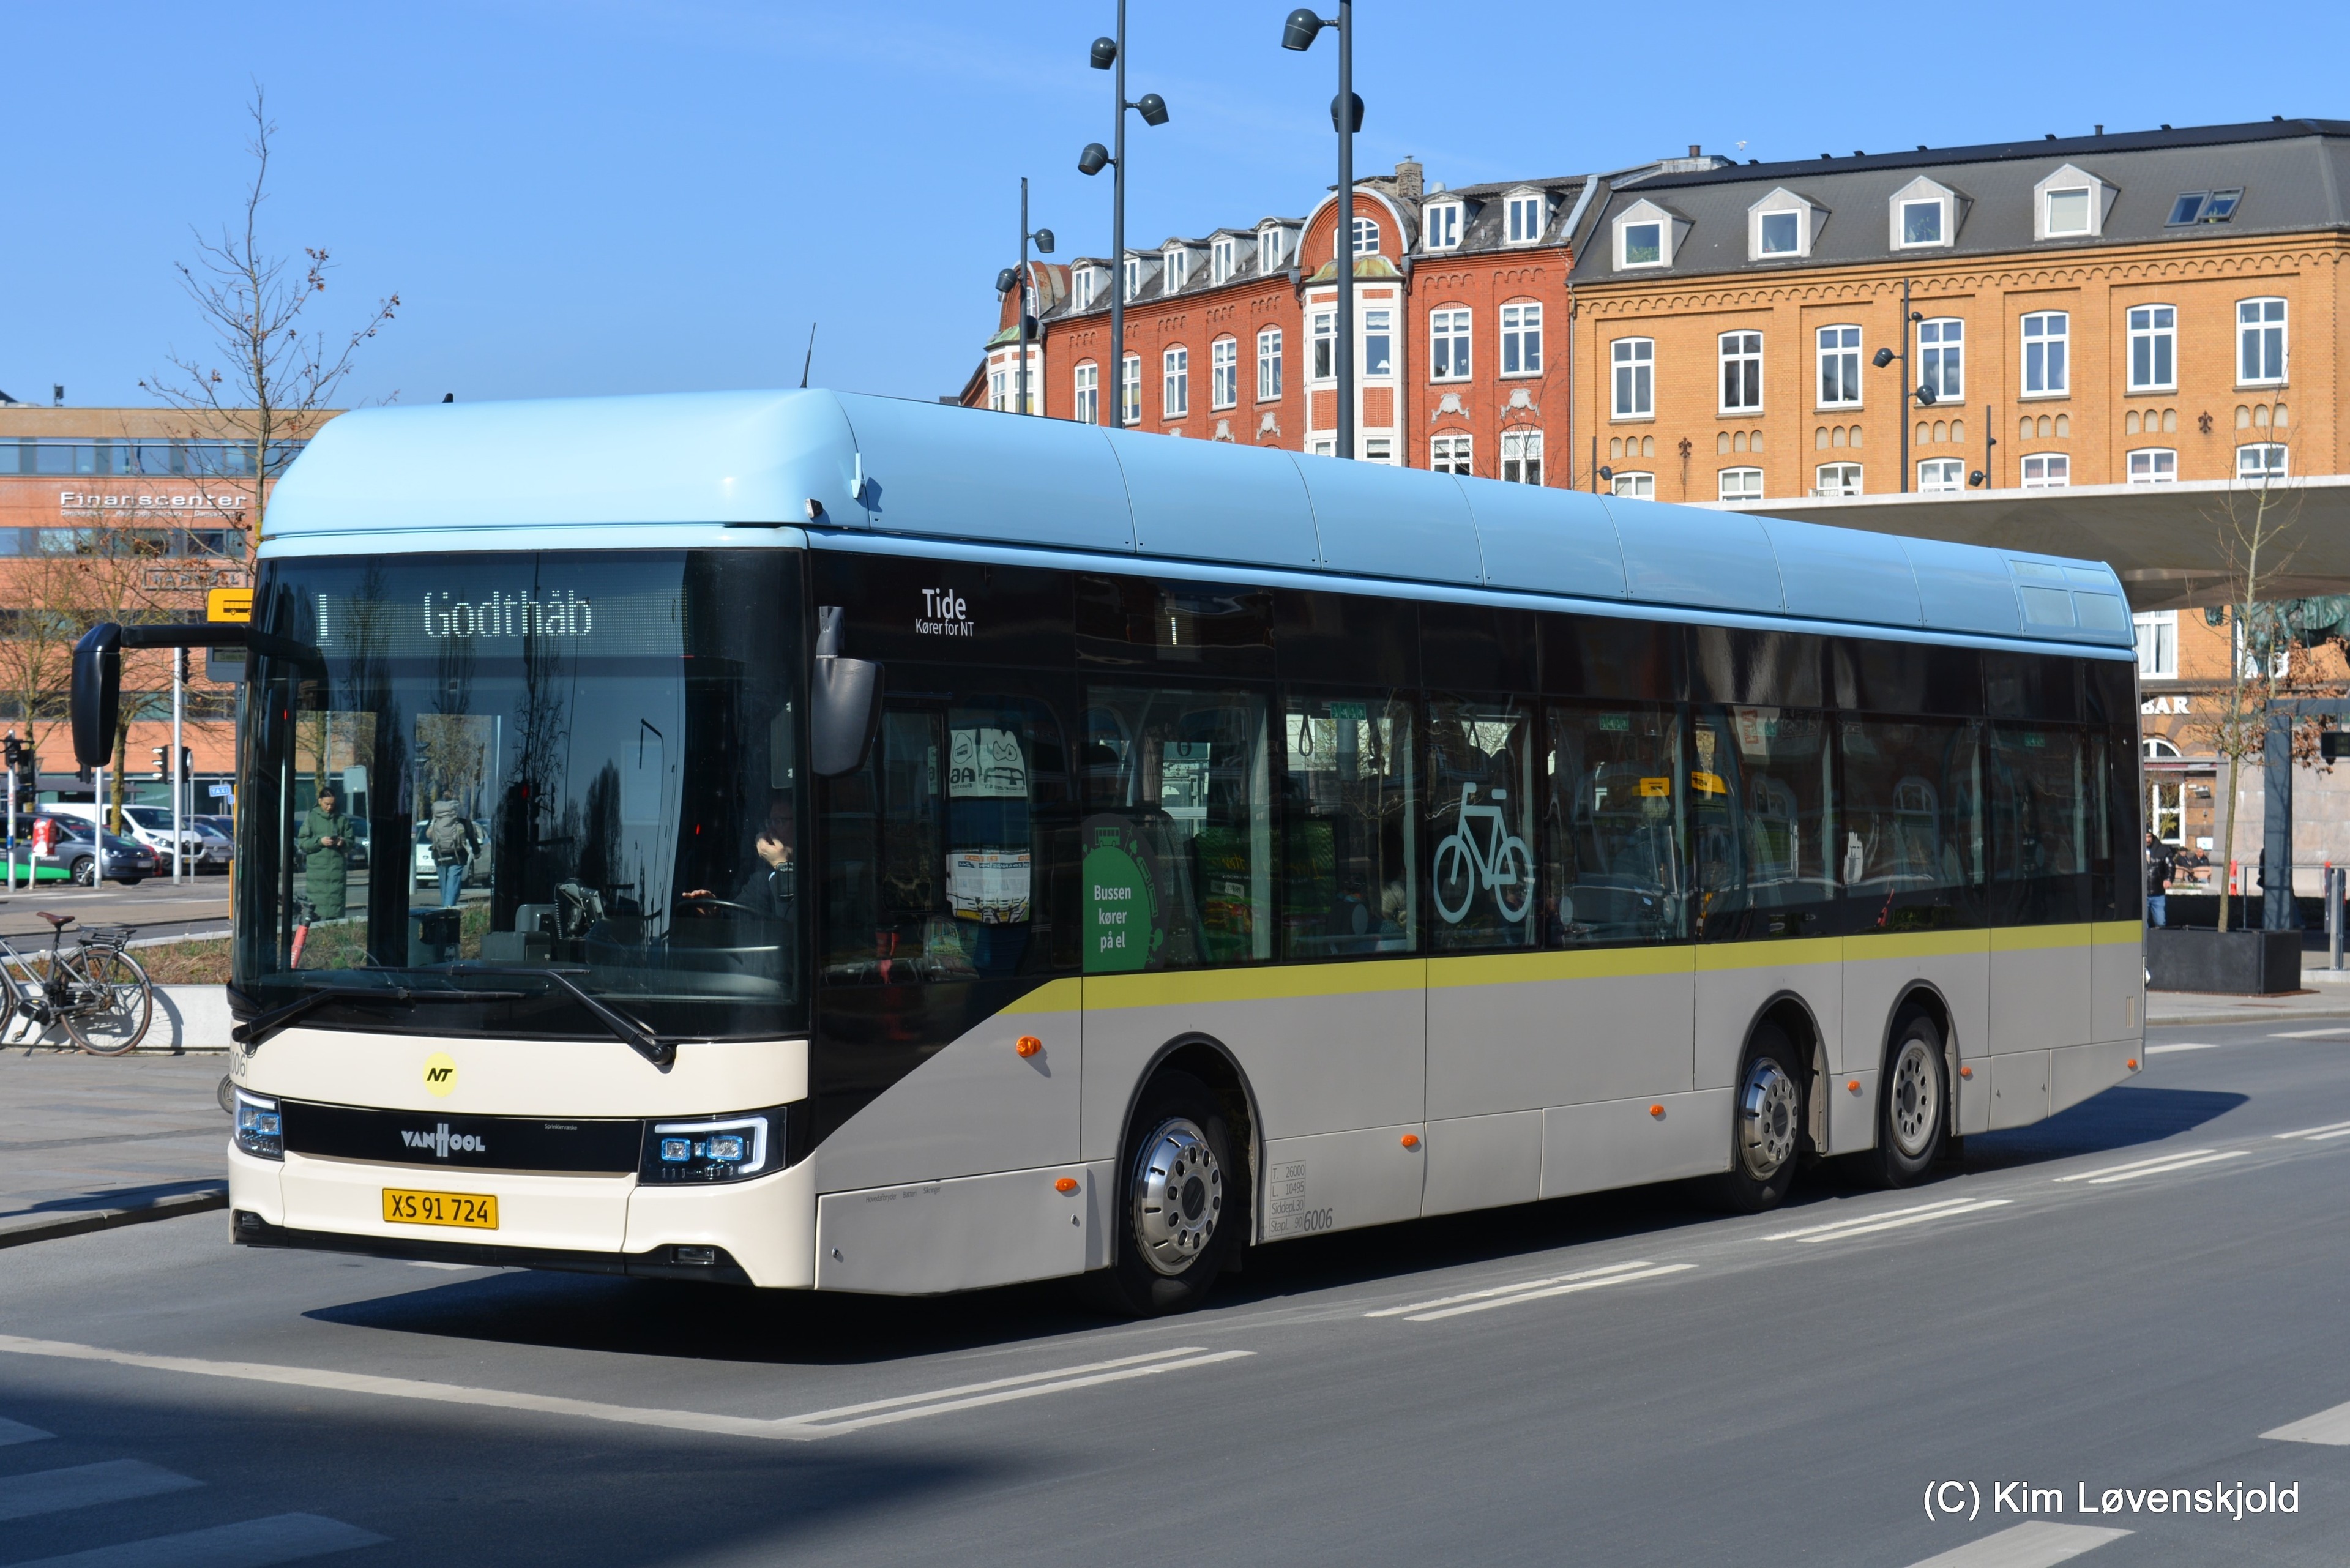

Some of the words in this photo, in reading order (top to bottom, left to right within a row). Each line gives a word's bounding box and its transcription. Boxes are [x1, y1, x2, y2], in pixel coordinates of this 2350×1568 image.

[61, 491, 247, 506] Finanscenter
[922, 588, 966, 620] Tide
[916, 618, 943, 635] Kører
[944, 619, 959, 636] for
[960, 621, 974, 637] NT
[2141, 695, 2191, 715] BAR
[1094, 885, 1131, 900] Bussen
[1099, 908, 1127, 925] kører
[1100, 931, 1113, 953] på
[1116, 931, 1125, 948] el
[427, 1067, 453, 1082] NT
[1272, 1168, 1278, 1180] T.
[1286, 1164, 1305, 1178] 26000
[1272, 1185, 1278, 1197] L.
[1286, 1181, 1304, 1195] 10495
[392, 1195, 417, 1218] XS
[422, 1197, 444, 1220] 91
[451, 1198, 488, 1223] 724
[1294, 1216, 1302, 1229] 90
[1304, 1208, 1333, 1232] 6006
